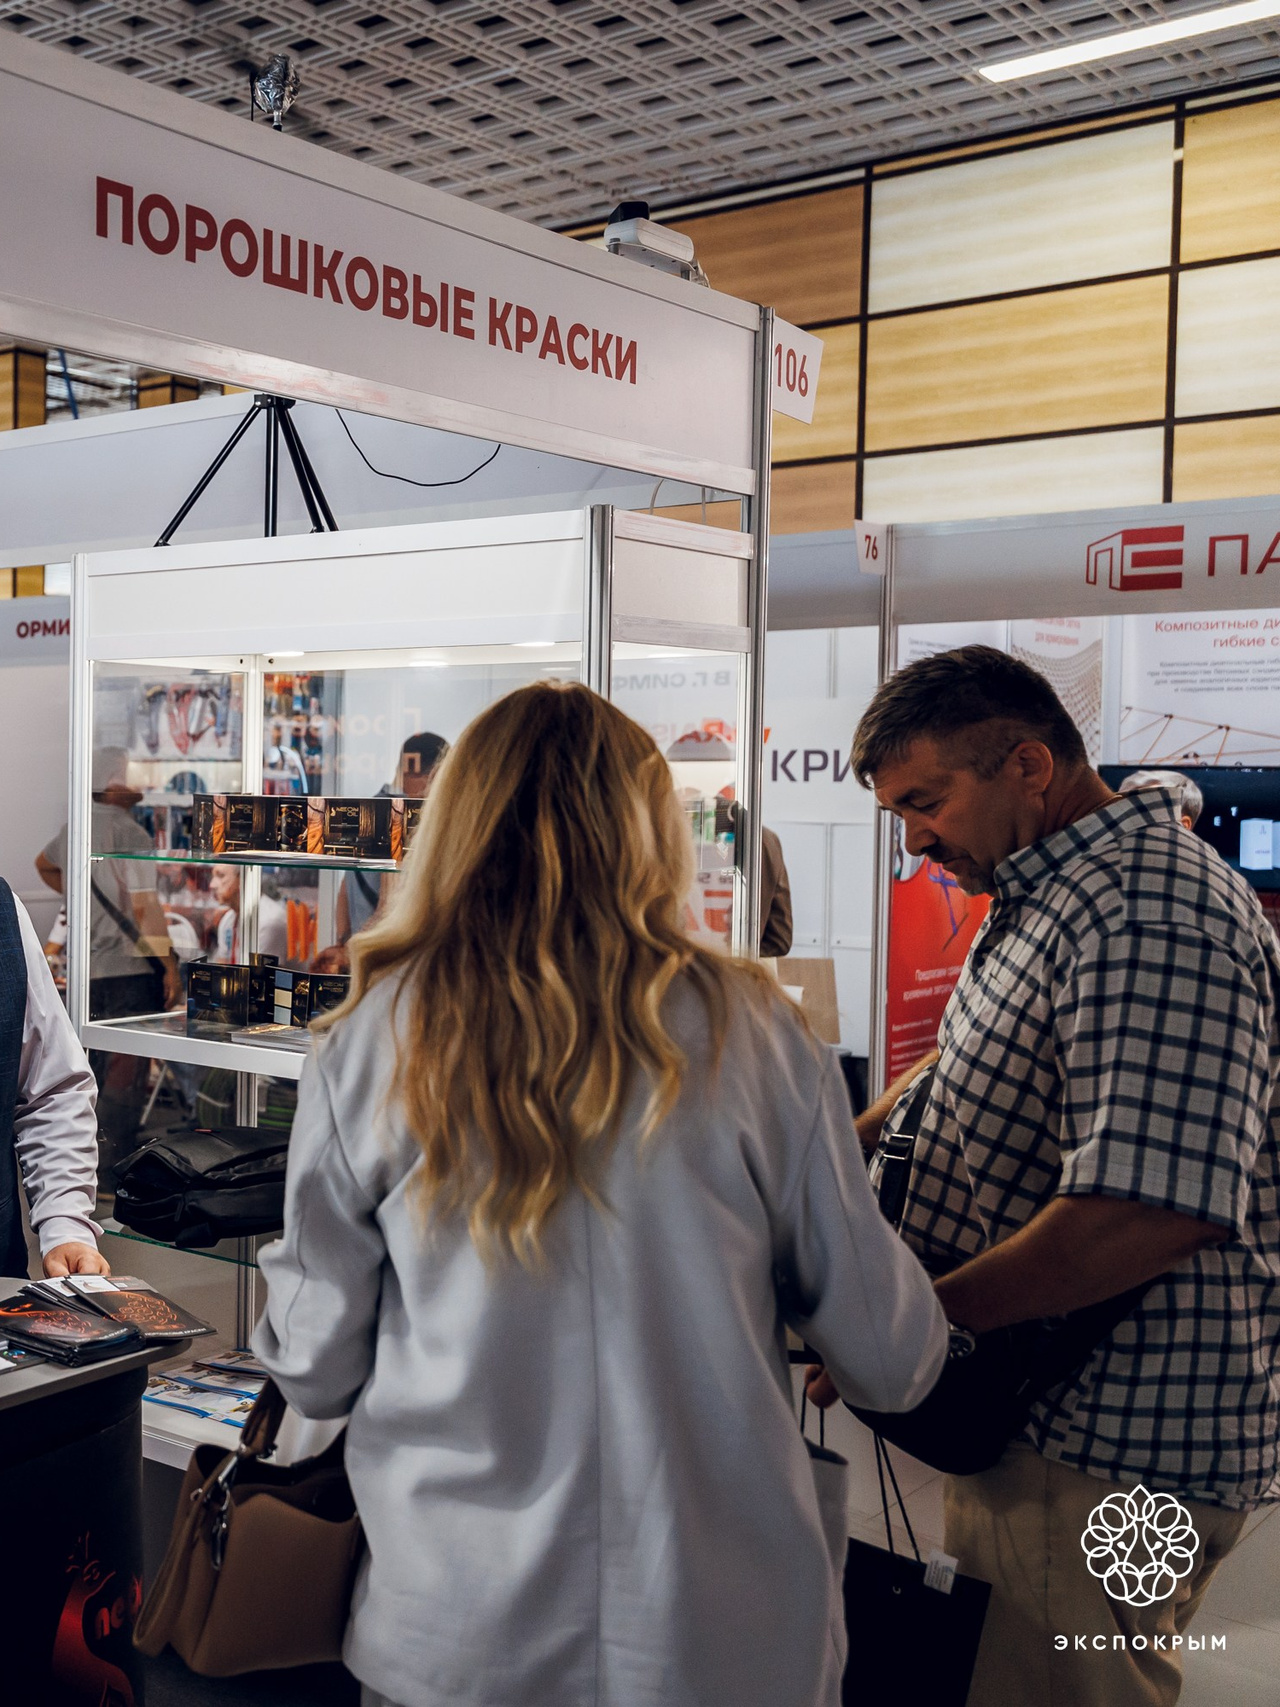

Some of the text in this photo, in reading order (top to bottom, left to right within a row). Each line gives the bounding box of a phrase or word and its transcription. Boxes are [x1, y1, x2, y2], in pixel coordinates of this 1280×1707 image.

[94, 176, 639, 386] ПОРОШКОВЫЕ КРАСКИ
[775, 343, 808, 397] 106
[864, 534, 879, 561] 76
[1155, 619, 1259, 632] Композитные
[1213, 635, 1266, 648] гибкие
